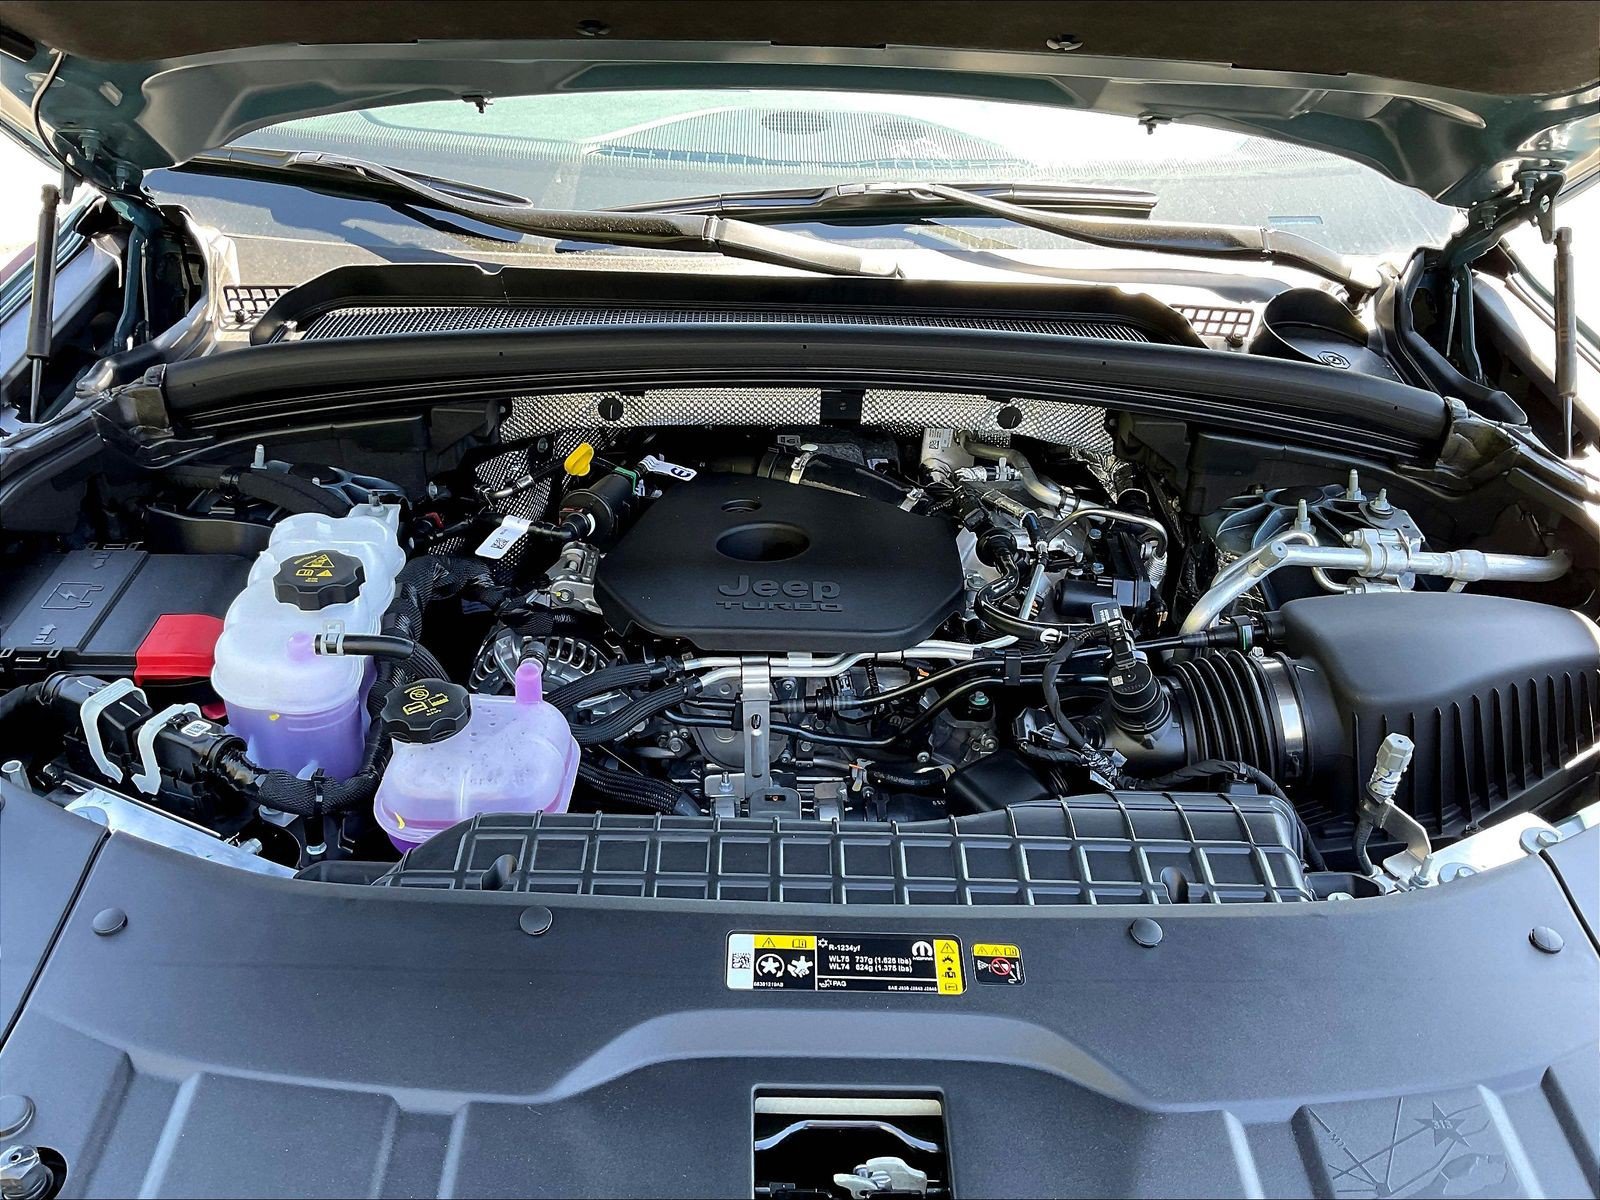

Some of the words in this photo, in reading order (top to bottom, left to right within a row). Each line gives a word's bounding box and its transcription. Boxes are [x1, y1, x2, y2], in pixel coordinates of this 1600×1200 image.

[718, 574, 841, 602] Jeep
[715, 601, 843, 612] TURBO
[828, 944, 861, 953] R-1234yf
[855, 956, 873, 965] 737g
[897, 957, 912, 966] lbs)
[898, 965, 913, 973] lbs)
[1432, 1119, 1453, 1130] 313
